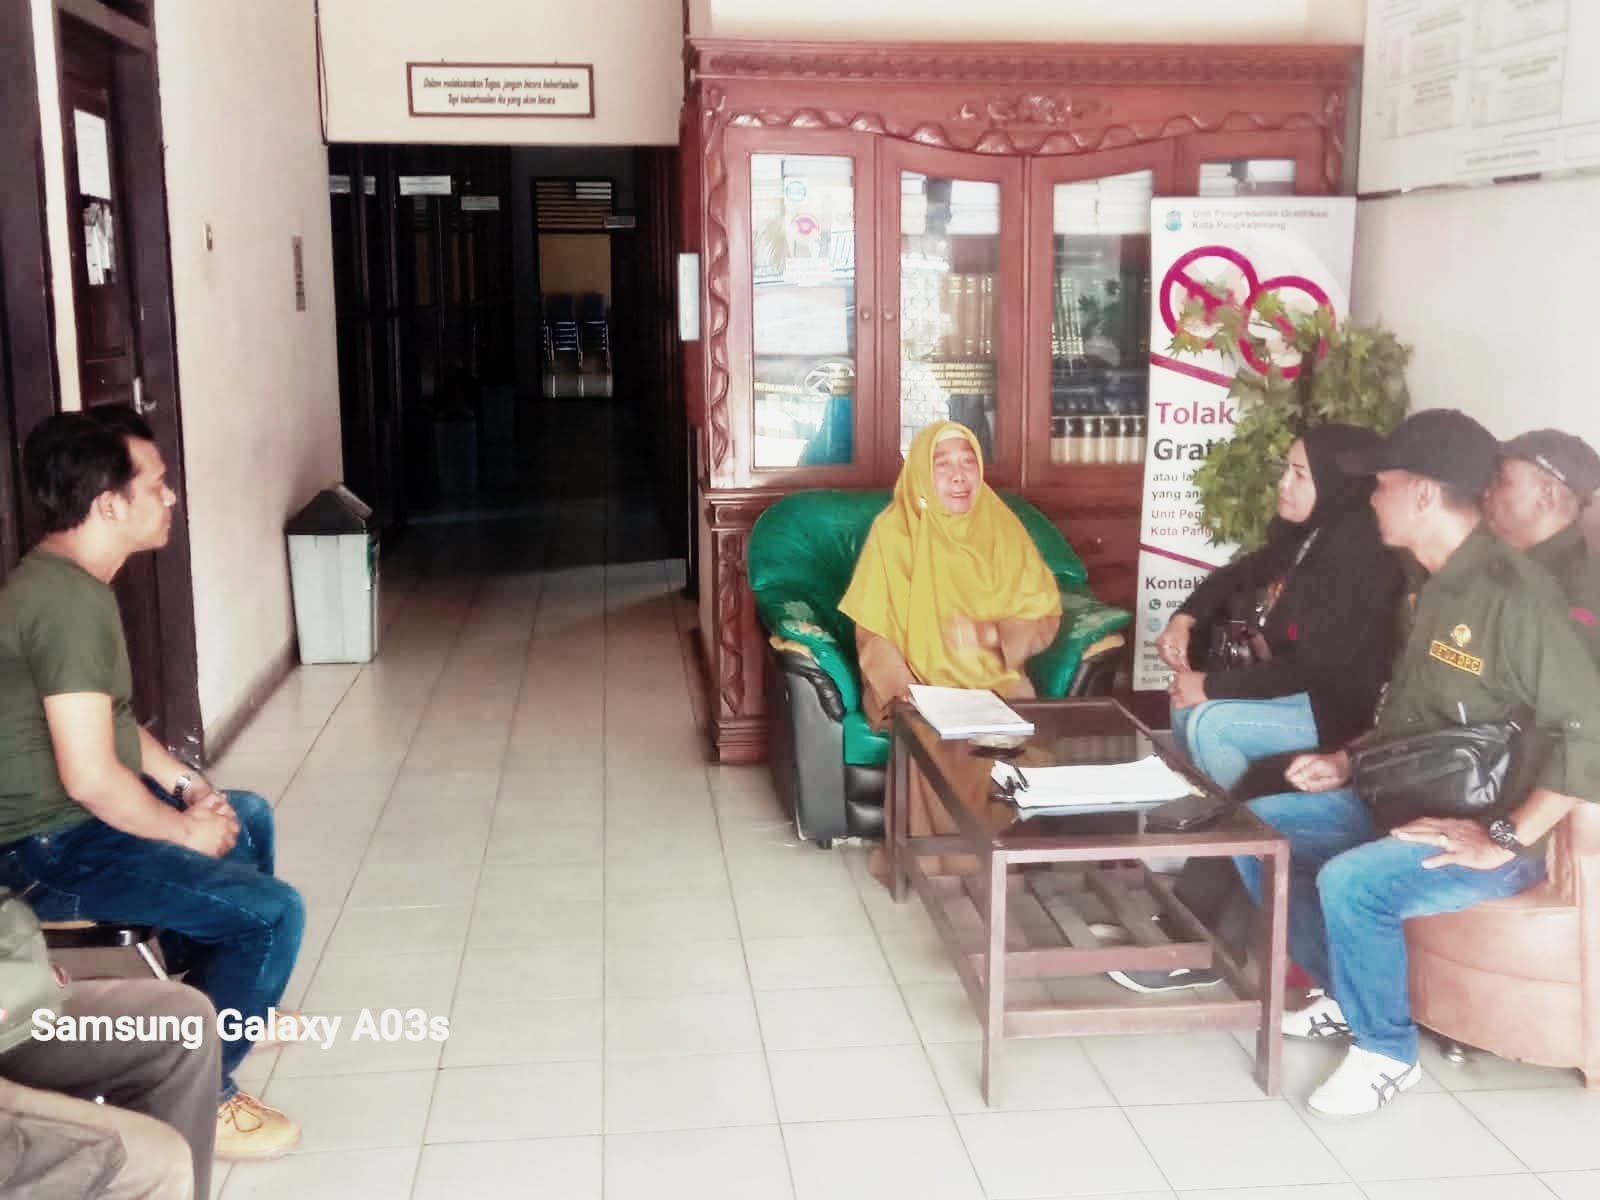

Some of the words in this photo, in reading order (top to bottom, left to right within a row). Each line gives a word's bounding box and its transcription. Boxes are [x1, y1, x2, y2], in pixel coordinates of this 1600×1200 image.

[1154, 400, 1235, 425] Tolak
[1152, 472, 1178, 481] atau
[1151, 490, 1181, 501] yang
[1151, 509, 1175, 519] Unit
[1150, 526, 1178, 537] Kota
